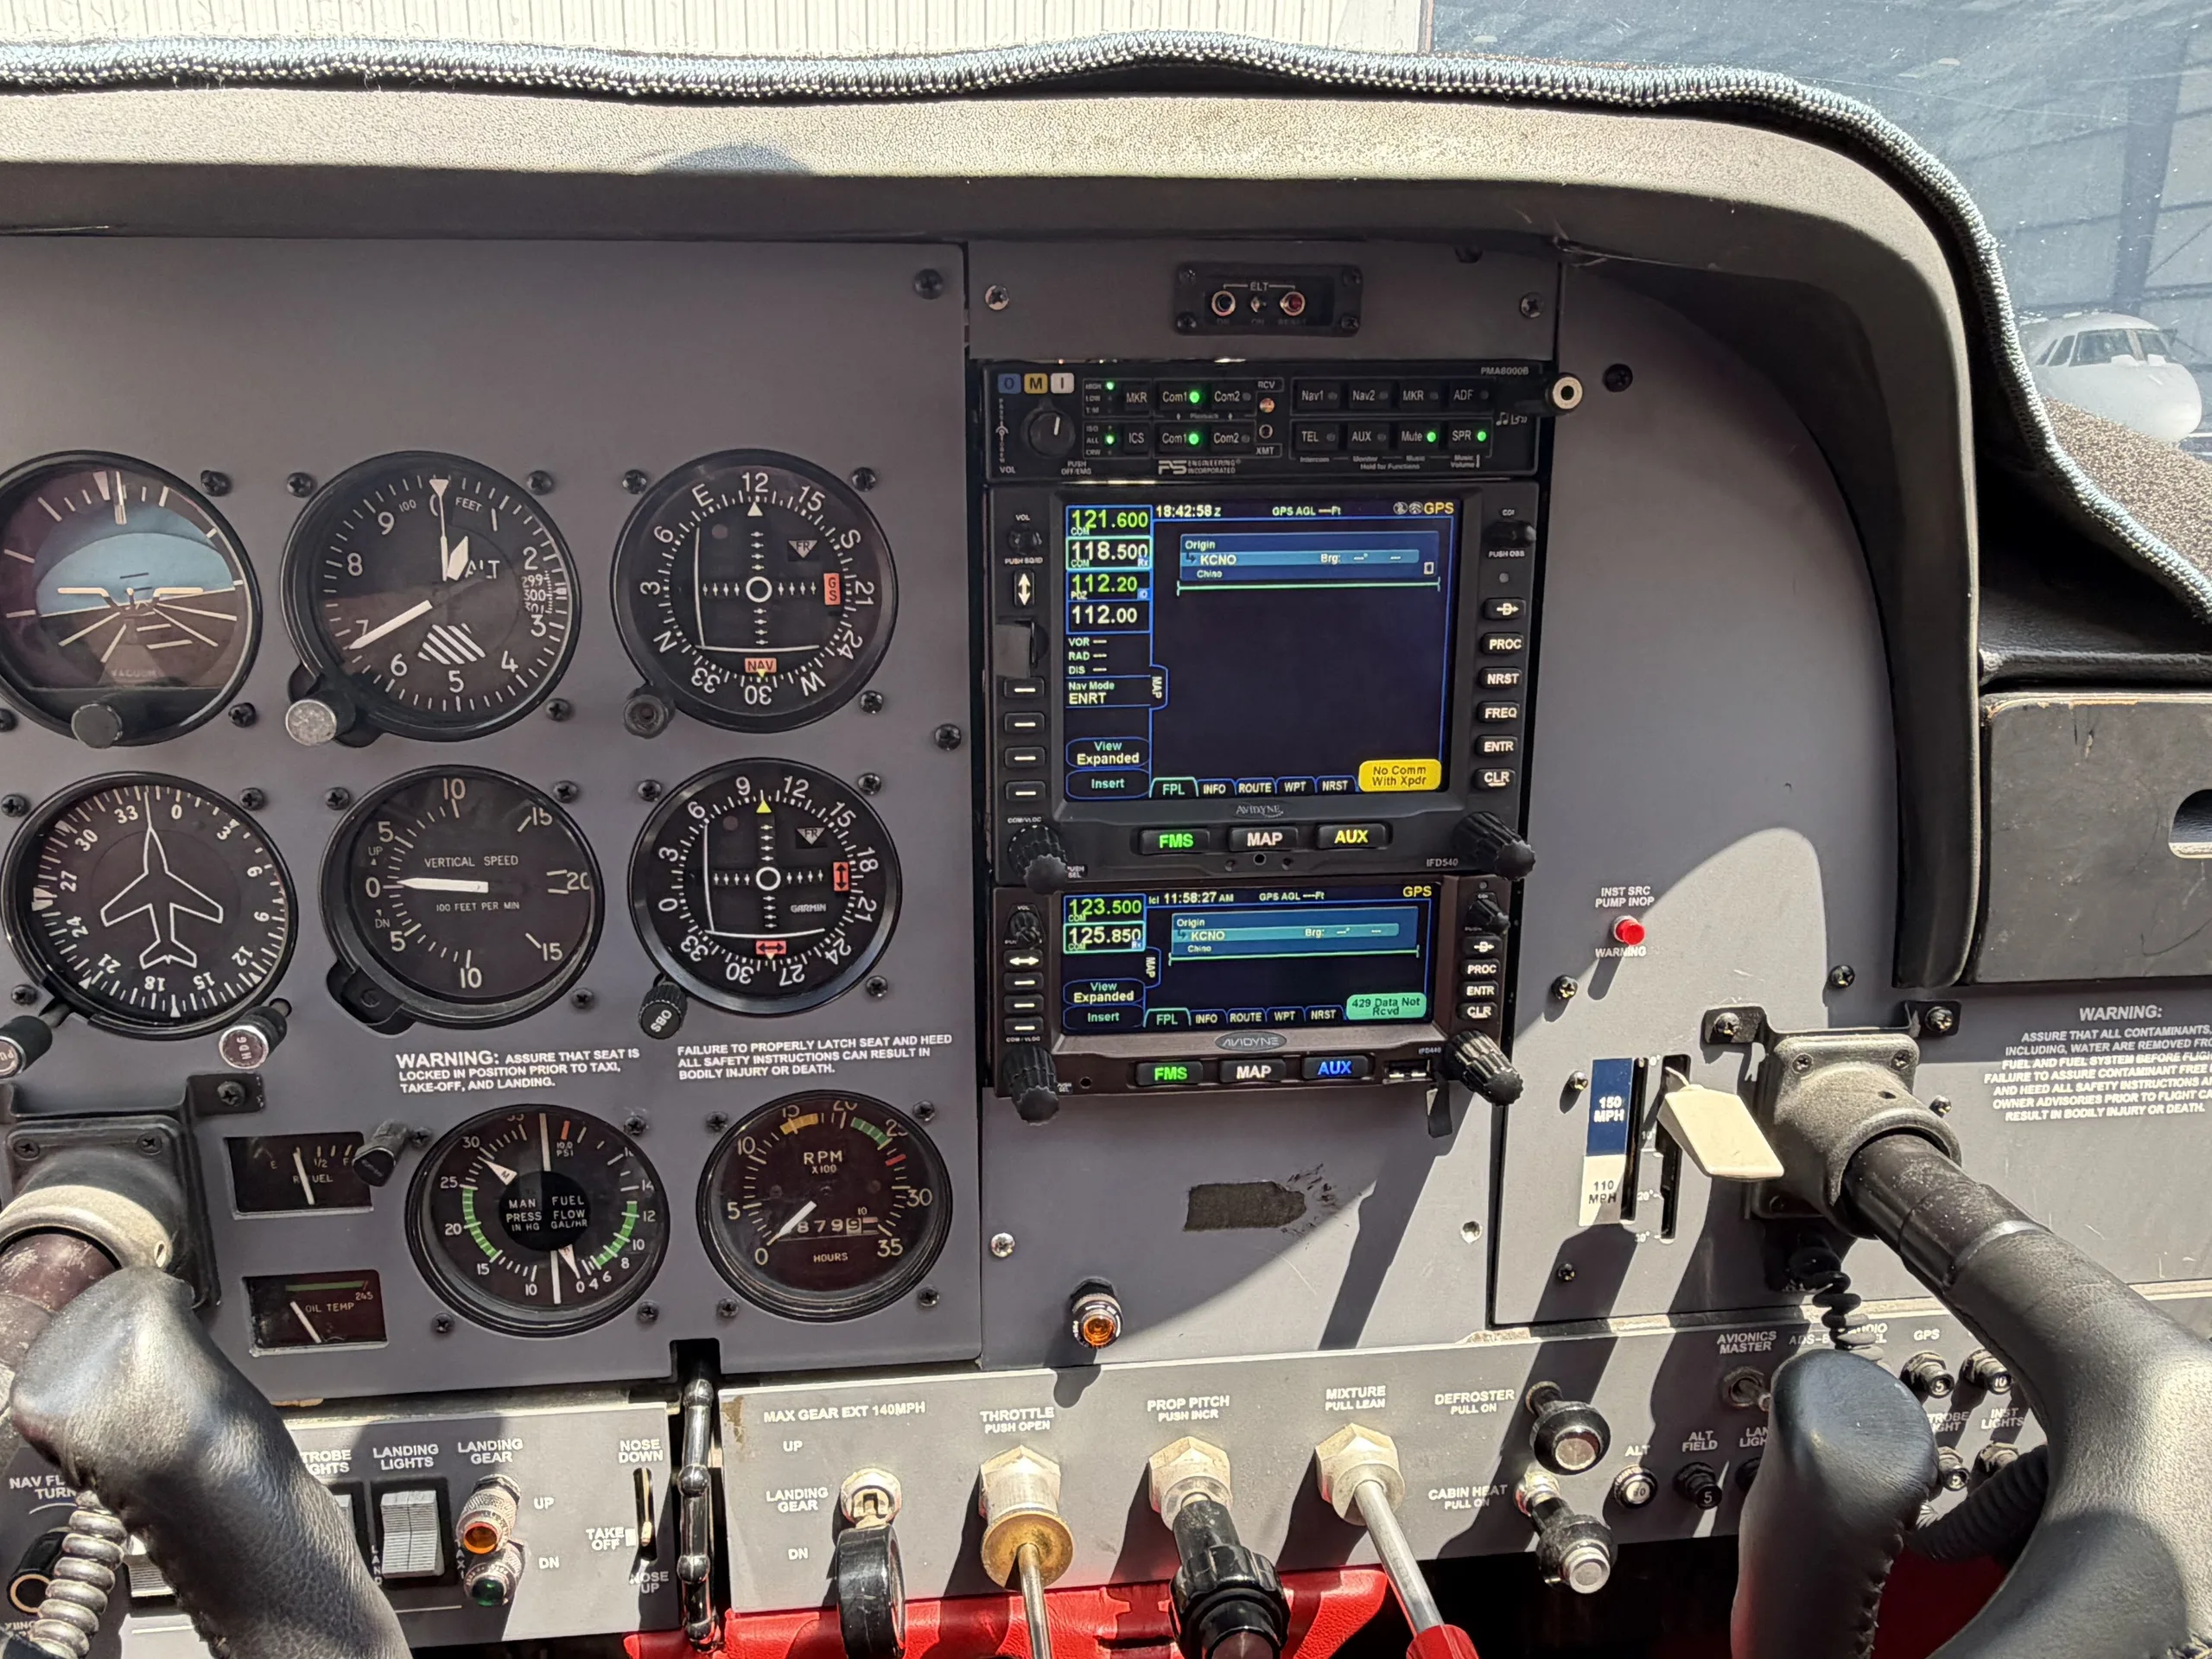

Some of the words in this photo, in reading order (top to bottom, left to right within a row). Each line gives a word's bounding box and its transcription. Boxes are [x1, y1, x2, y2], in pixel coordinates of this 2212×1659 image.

[1250, 282, 1268, 291] ELT
[1481, 366, 1529, 376] PMA8000B
[1126, 392, 1147, 404] MKR
[1162, 391, 1187, 403] Com1
[1214, 391, 1240, 403] Com2
[1302, 391, 1324, 401] Nav1
[1352, 391, 1375, 401] Nav2
[1402, 391, 1424, 401] MKR
[1453, 390, 1474, 400] ADF
[1128, 433, 1144, 444] ICS
[1162, 433, 1187, 444] Com1
[1213, 433, 1239, 444] Com2
[1302, 431, 1319, 442] TEL
[1351, 431, 1371, 442] AUX
[1402, 431, 1422, 442] Mute
[1452, 431, 1471, 441] SPR
[741, 472, 768, 493] 12
[1156, 504, 1211, 518] 18:42:58
[1424, 502, 1454, 514] GPS
[1071, 509, 1148, 529] 121.600
[1071, 541, 1148, 561] 118.500
[1185, 540, 1216, 552] Origin
[1199, 555, 1236, 566] KCNO
[1071, 574, 1138, 593] 112.20
[1071, 605, 1138, 624] 112.00
[1069, 638, 1090, 646] VOR
[1489, 639, 1522, 650] PROC
[1069, 652, 1090, 661] RAD
[747, 660, 773, 671] NAV
[448, 671, 464, 692] 5
[1487, 673, 1519, 684] NRST
[1069, 682, 1087, 690] Nav
[1089, 681, 1115, 690] Mode
[1069, 692, 1106, 704] ENRT
[1484, 707, 1517, 719] FREQ
[1094, 741, 1122, 751] View
[1484, 741, 1514, 753] ENTR
[1077, 753, 1140, 766] Expanded
[1372, 766, 1388, 776] No
[1391, 765, 1427, 775] Comm
[1372, 776, 1398, 786] With
[1400, 775, 1427, 788] Xpdr
[1484, 772, 1510, 783] CLR
[442, 779, 466, 800] 10
[1091, 779, 1125, 789] Insert
[1162, 784, 1185, 795] FPL
[1203, 784, 1226, 794] INFO
[1238, 782, 1272, 794] ROUTE
[1284, 781, 1306, 792] WPT
[1322, 780, 1348, 791] NRST
[1159, 834, 1194, 849] FMS
[1247, 832, 1283, 847] MAP
[1334, 830, 1369, 844] AUX
[424, 856, 475, 868] VERTICAL
[483, 855, 518, 866] SPEED
[1426, 858, 1458, 868] IFD540
[1402, 886, 1432, 898] GPS
[1601, 887, 1626, 898] INST
[1628, 886, 1650, 896] SRC
[1164, 892, 1217, 905] 11:58:27
[1218, 893, 1234, 903] AM
[1595, 897, 1627, 908] PUMP
[1628, 894, 1655, 906] INOP
[1068, 899, 1141, 916] 123.500
[1068, 927, 1141, 944] 125.850
[1191, 931, 1225, 941] KCNO
[1595, 946, 1647, 958] WARNING
[1352, 998, 1371, 1008] 429
[1375, 998, 1398, 1007] Data
[1402, 997, 1421, 1007] Not
[1372, 1006, 1400, 1016] Rcvd
[2079, 1005, 2163, 1021] WARNING:
[1156, 1014, 1178, 1026] FPL
[1196, 1014, 1218, 1024] INFO
[1230, 1012, 1262, 1023] ROUTE
[1274, 1011, 1296, 1021] WPT
[1311, 1009, 1336, 1020] NRST
[2021, 1030, 2068, 1043] ASSURE
[2069, 1029, 2099, 1040] THAT
[2101, 1028, 2122, 1039] ALL
[2124, 1025, 2212, 1038] CONTAMINANTS,
[677, 1044, 728, 1056] FAILURE
[731, 1043, 747, 1053] TO
[751, 1040, 814, 1052] PROPERLY
[817, 1039, 855, 1050] LATCH
[859, 1037, 890, 1047] SEAT
[892, 1035, 918, 1046] AND
[920, 1034, 952, 1045] HEED
[1222, 1037, 1280, 1046] AVIDYNE
[396, 1050, 499, 1069] WARNING:
[505, 1052, 556, 1065] ASSURE
[558, 1051, 591, 1062] THAT
[594, 1049, 626, 1060] SEAT
[628, 1048, 640, 1058] IS
[678, 1057, 702, 1068] ALL
[704, 1055, 750, 1067] SAFETY
[753, 1052, 840, 1065] INSTRUCTIONS
[842, 1050, 868, 1061] CAN
[870, 1048, 916, 1059] RESULT
[918, 1047, 931, 1057] IN
[399, 1069, 450, 1082] LOCKED
[454, 1069, 466, 1079] IN
[469, 1066, 526, 1078] POSITION
[530, 1064, 567, 1076] PRIOR
[571, 1063, 588, 1073] TO
[590, 1062, 621, 1074] TAXI,
[679, 1068, 723, 1080] BODILY
[726, 1066, 769, 1078] INJURY
[771, 1065, 790, 1076] OR
[792, 1064, 836, 1075] DEATH.
[1154, 1067, 1188, 1081] FMS
[1236, 1065, 1272, 1079] MAP
[1318, 1061, 1352, 1076] AUX
[400, 1081, 466, 1094] TAKE-OFF,
[468, 1079, 495, 1091] AND
[498, 1077, 556, 1090] LANDING.
[1599, 1096, 1622, 1109] 150
[1593, 1109, 1624, 1122] MPH
[804, 1151, 843, 1165] RPM
[440, 1177, 459, 1188] 25
[1593, 1179, 1614, 1192] 110
[551, 1196, 584, 1206] FUEL
[907, 1189, 932, 1205] 30
[1588, 1192, 1618, 1205] MPH
[509, 1198, 536, 1209] MAN
[506, 1211, 542, 1222] PRESS
[553, 1210, 585, 1220] FLOW
[813, 1253, 849, 1263] HOURS
[306, 1303, 321, 1313] OIL
[326, 1302, 355, 1313] TEMP
[1717, 1331, 1777, 1346] AVIONICS
[1913, 1328, 1940, 1341] GPS
[1719, 1340, 1772, 1355] MASTER
[1325, 1385, 1386, 1400] MIXTURE
[1434, 1389, 1515, 1406] DEFROSTER
[1147, 1397, 1186, 1412] PROP
[1189, 1395, 1230, 1409] PITCH
[764, 1409, 796, 1423] MAX
[798, 1408, 839, 1421] GEAR
[842, 1406, 868, 1418] EXT
[872, 1402, 925, 1417] 140MPH
[979, 1408, 1054, 1422] THROTTLE
[372, 1444, 439, 1459] LANDING
[458, 1438, 524, 1453] LANDING
[1682, 1440, 1718, 1452] FIELD
[380, 1457, 434, 1471] LIGHTS
[471, 1451, 513, 1465] GEAR
[1428, 1487, 1470, 1500] CABIN
[1472, 1484, 1508, 1497] HEAT
[586, 1527, 625, 1541] TAKE
